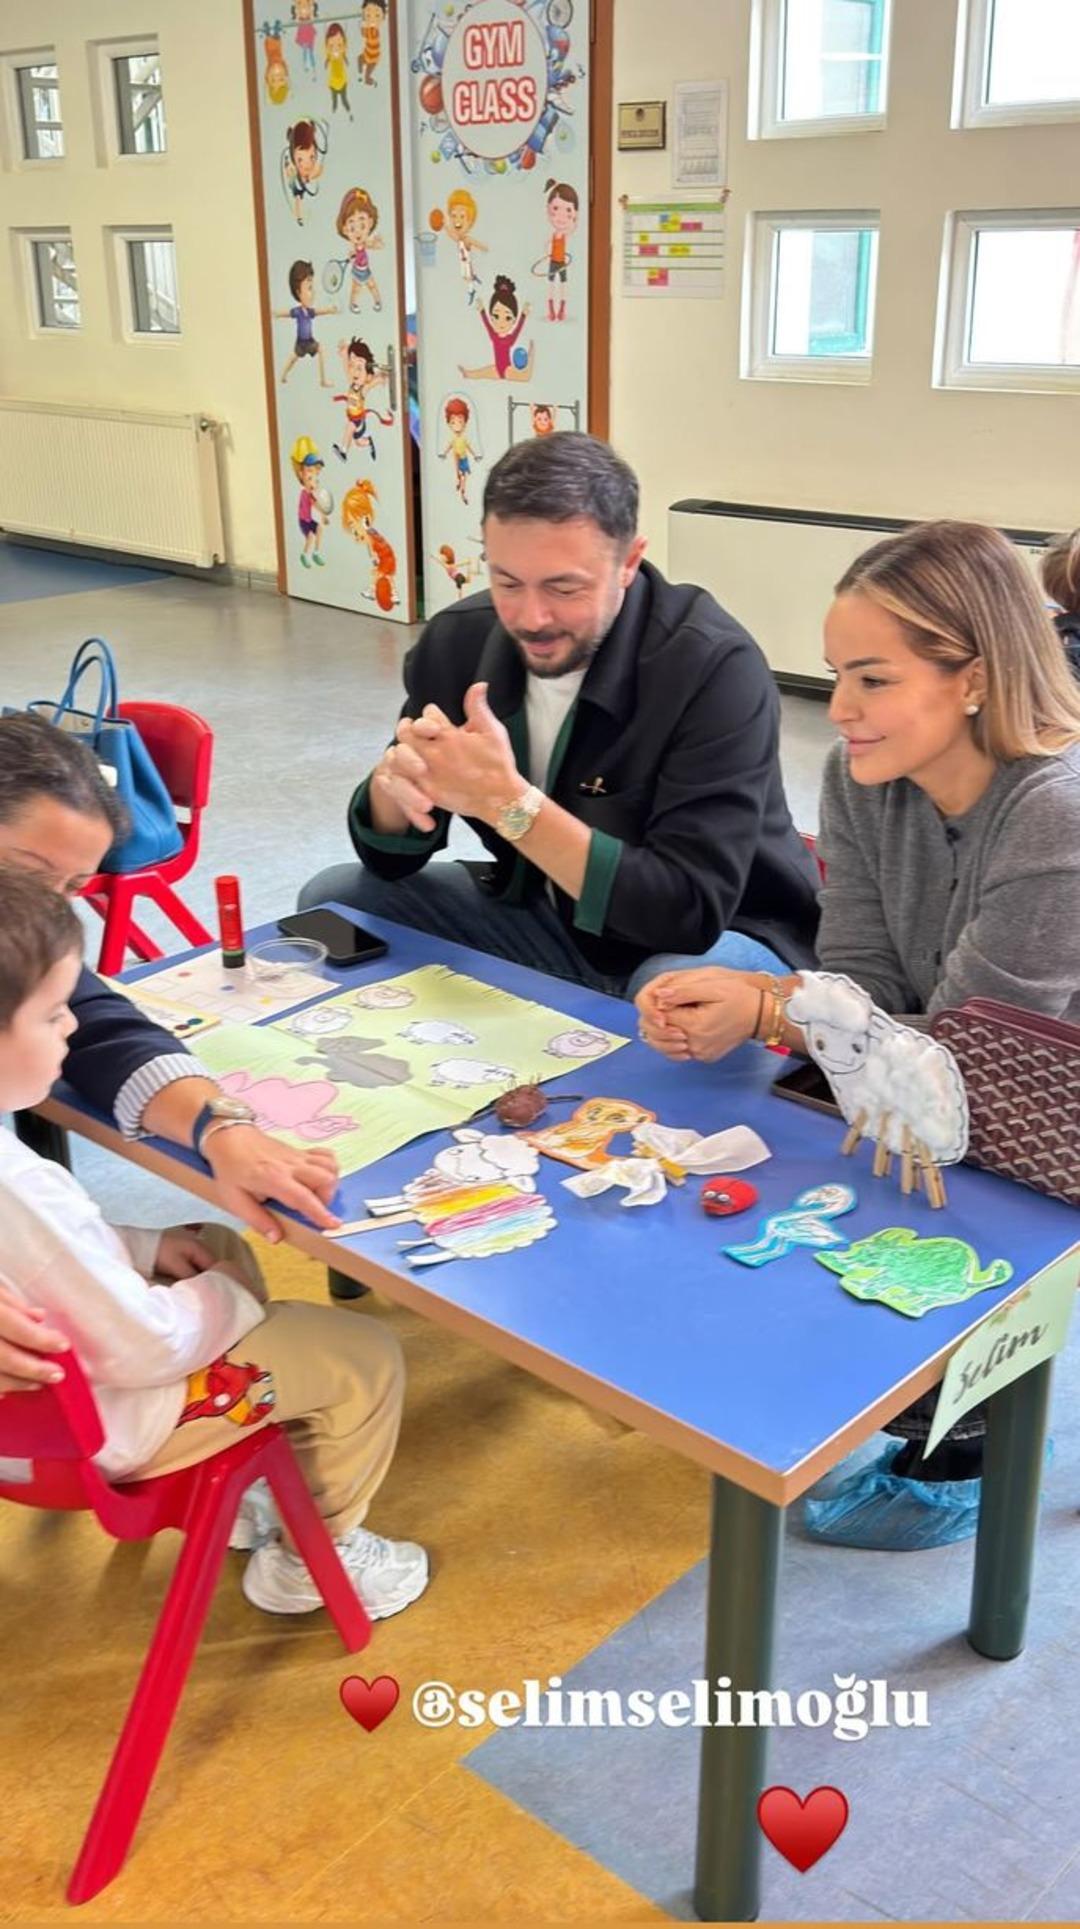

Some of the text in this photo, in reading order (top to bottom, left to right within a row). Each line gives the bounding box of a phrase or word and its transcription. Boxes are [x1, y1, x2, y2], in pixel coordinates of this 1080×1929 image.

[464, 20, 524, 70] GYM
[453, 76, 537, 125] CLASS
[953, 1323, 1049, 1405] Selim
